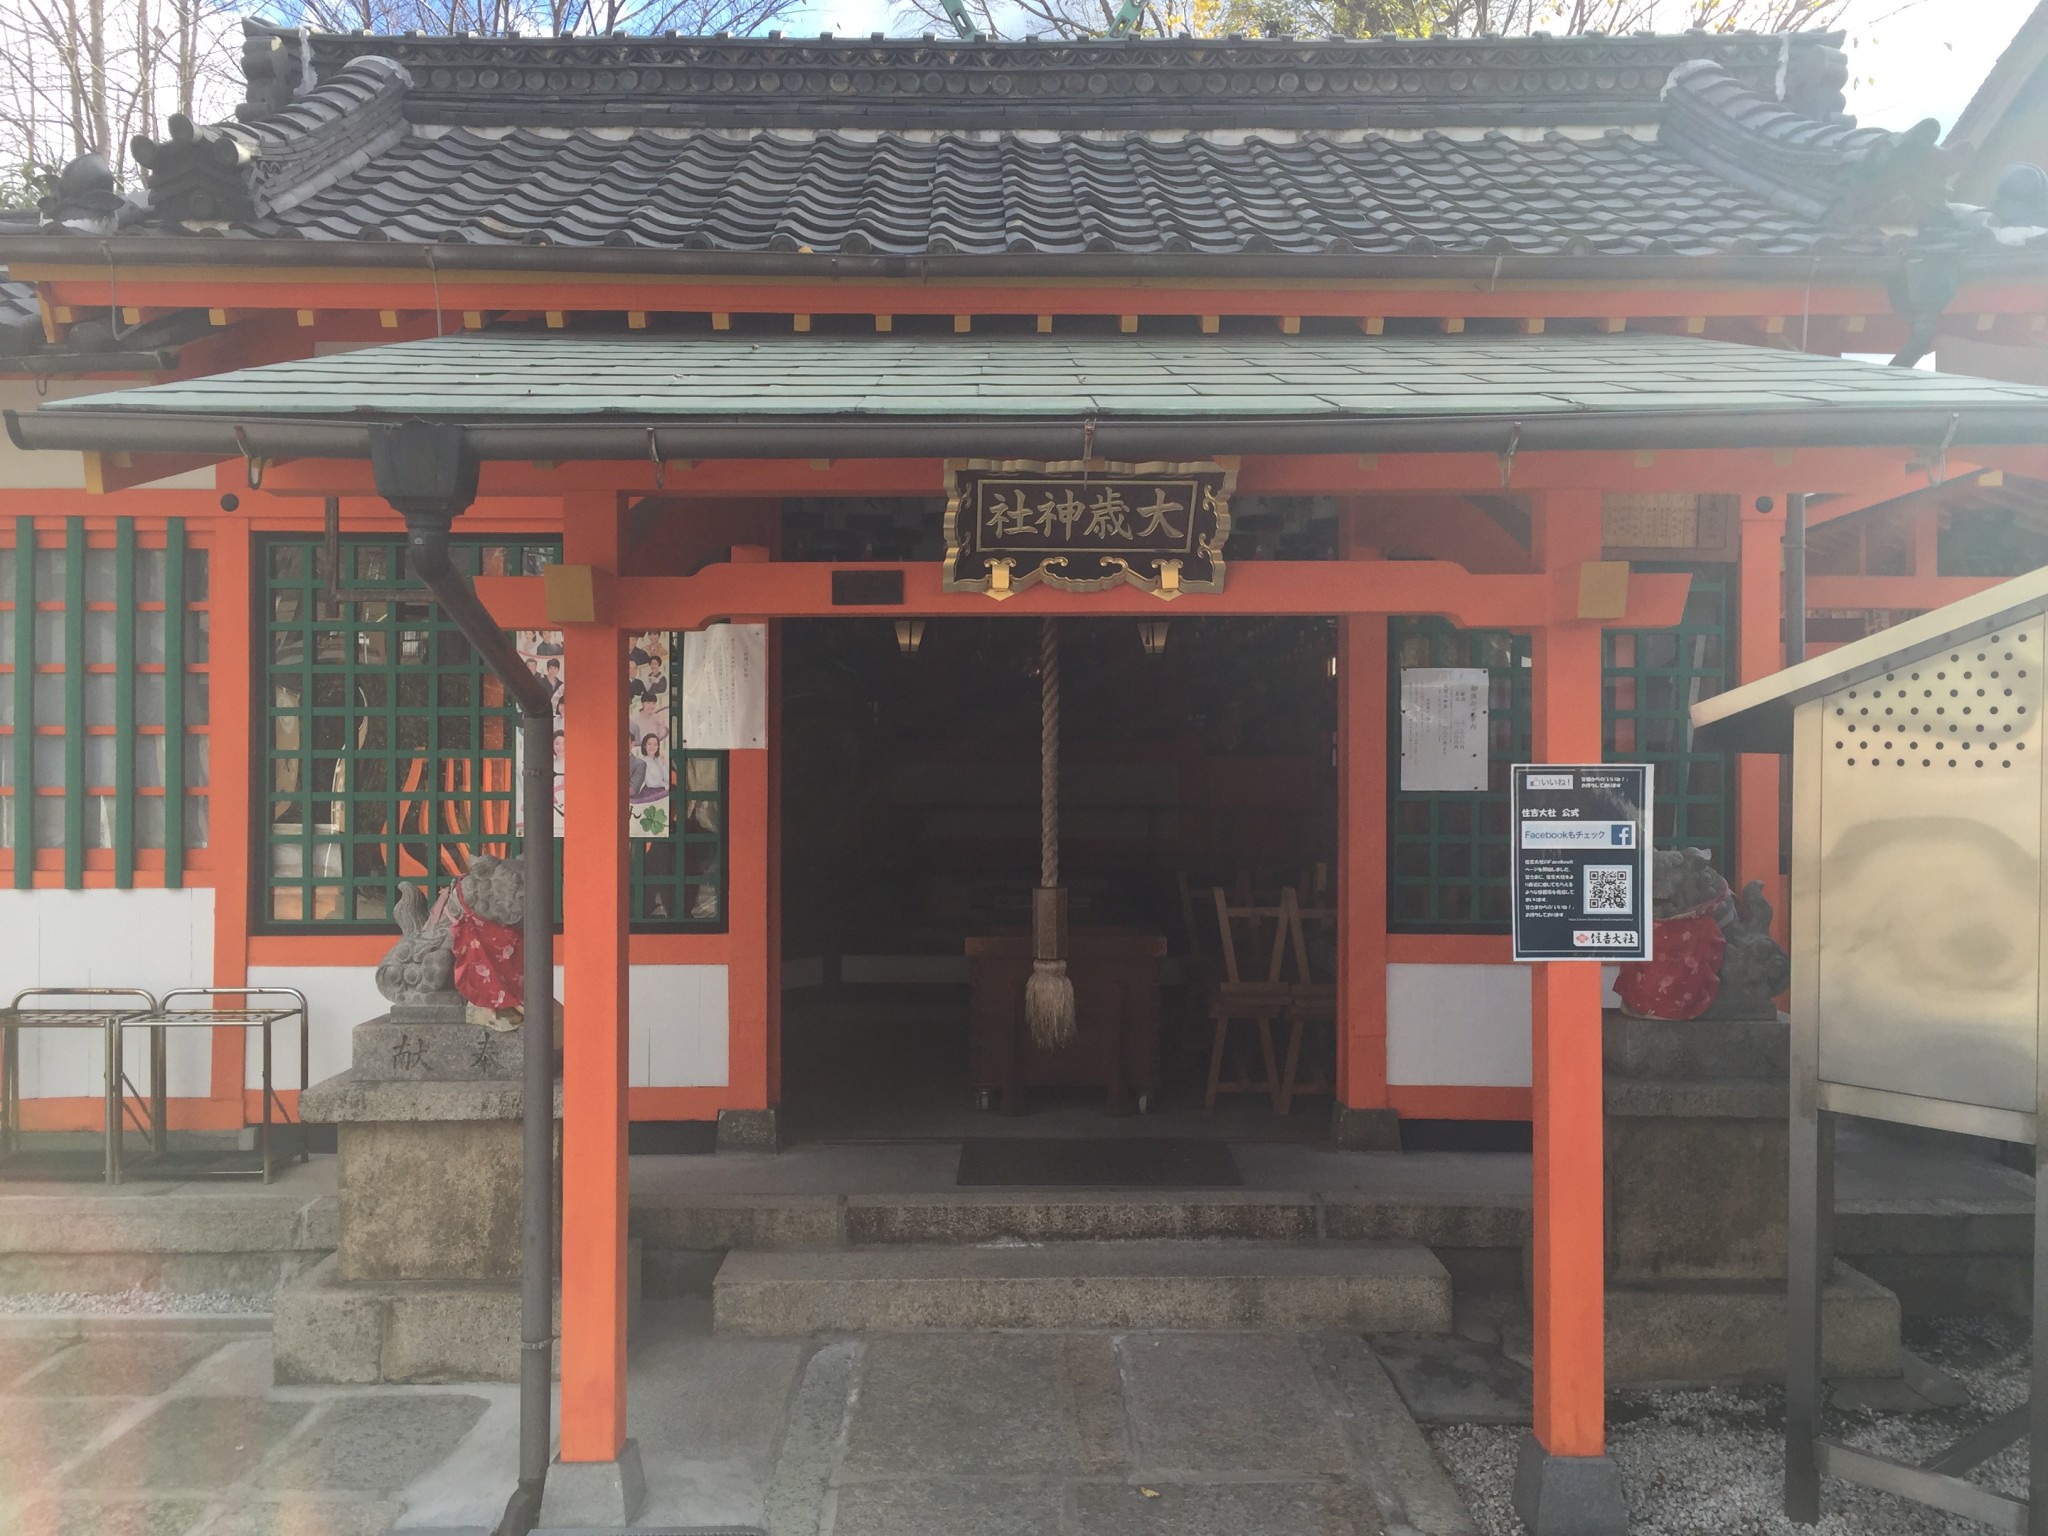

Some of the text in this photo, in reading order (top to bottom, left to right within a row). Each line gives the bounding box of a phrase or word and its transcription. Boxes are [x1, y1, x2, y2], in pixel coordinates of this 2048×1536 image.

[1521, 808, 1580, 818] 住吉大社 公式
[1524, 831, 1606, 840] Facebookもチェック
[1590, 932, 1636, 945] 住吉大社
